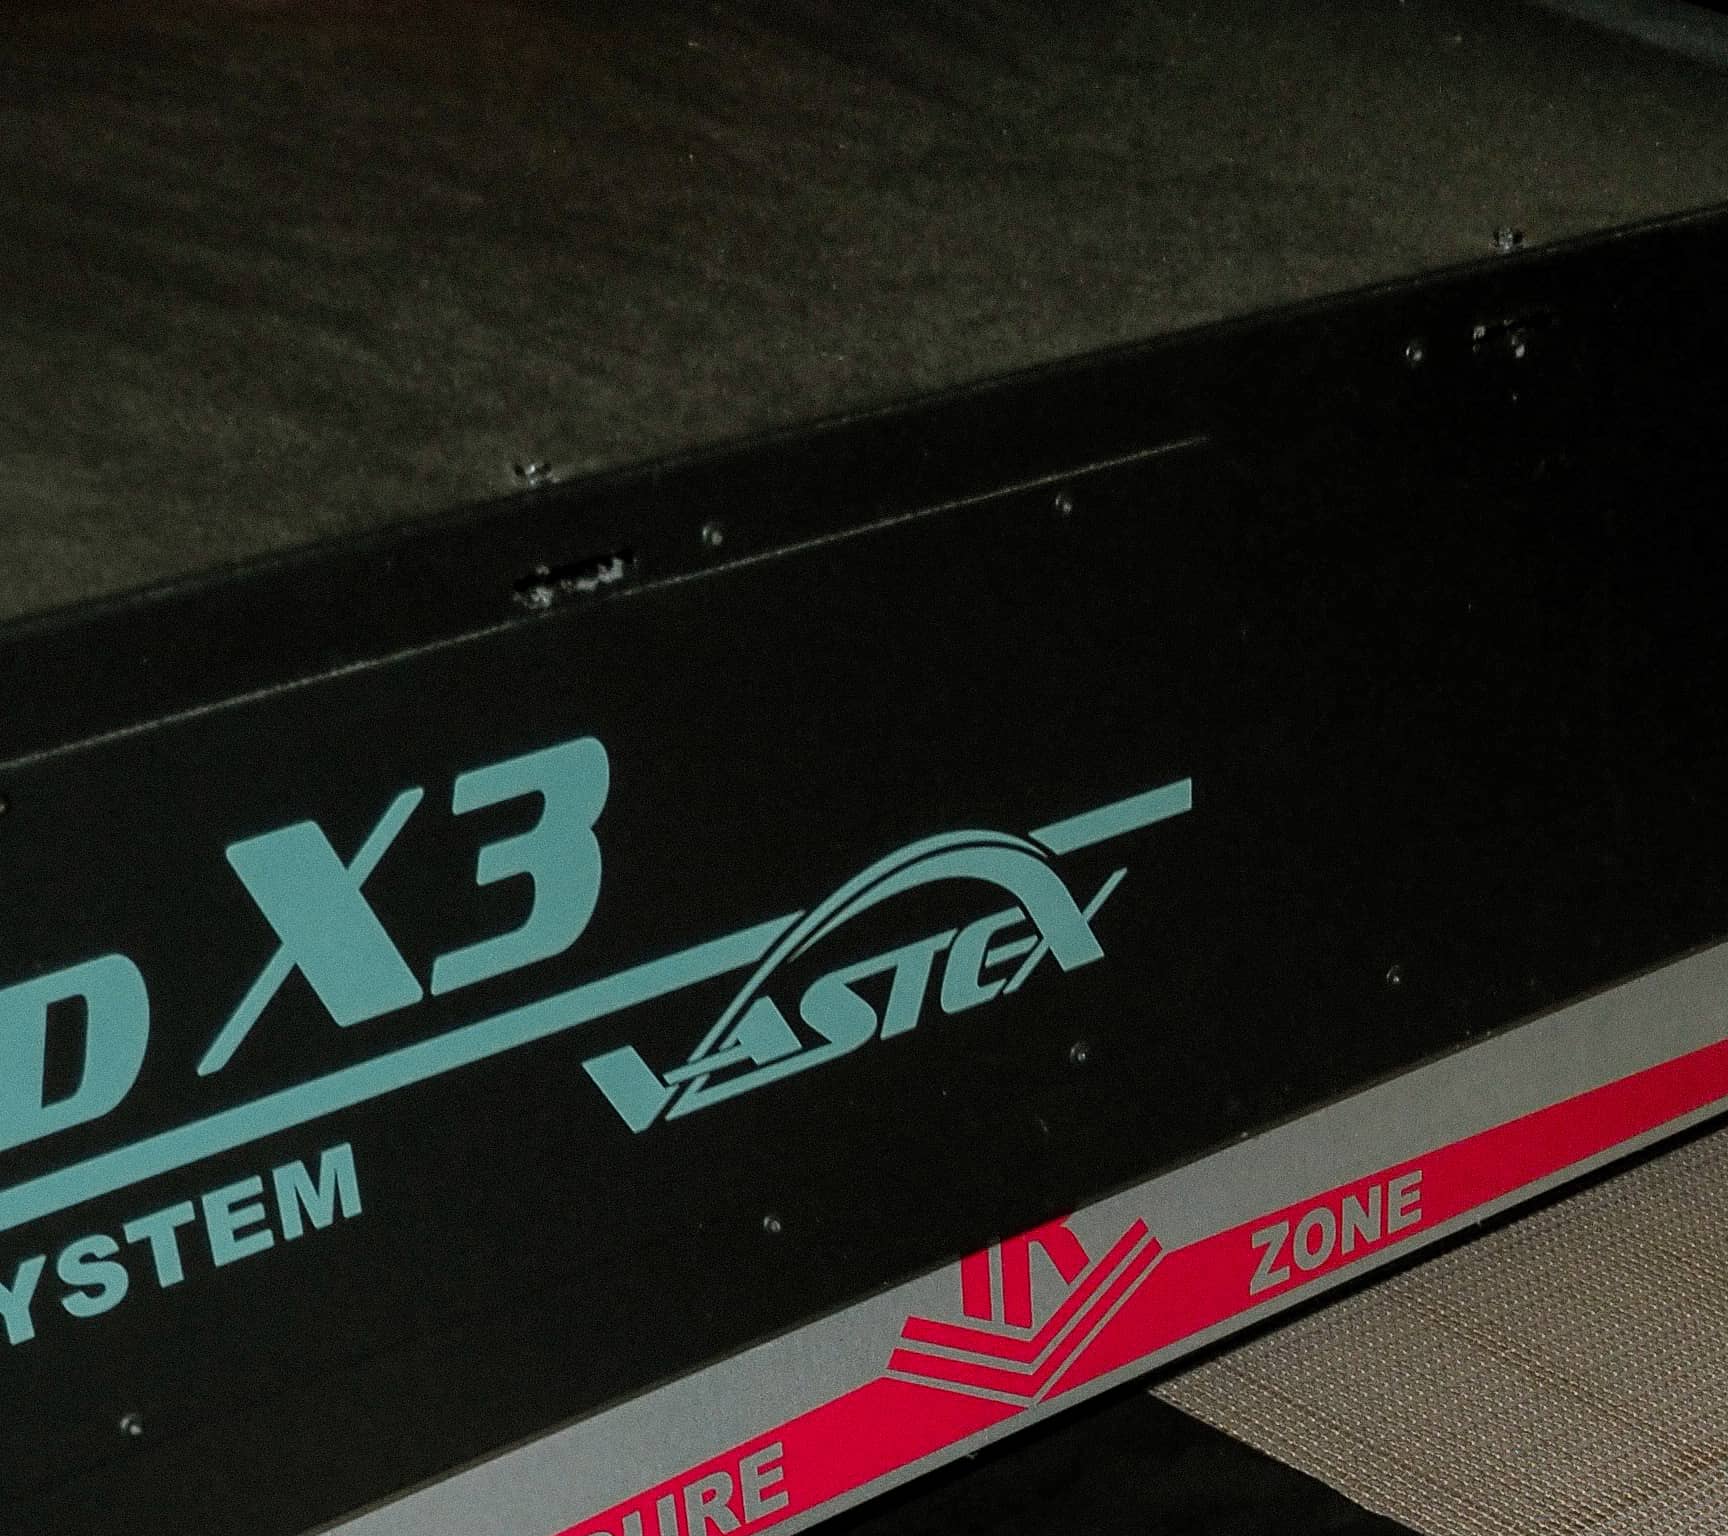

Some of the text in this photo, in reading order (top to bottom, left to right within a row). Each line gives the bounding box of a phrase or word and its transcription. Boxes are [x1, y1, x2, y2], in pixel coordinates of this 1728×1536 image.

[196, 736, 611, 1077] X3
[582, 828, 1127, 1133] VASTEX
[1248, 1169, 1423, 1296] ZONE
